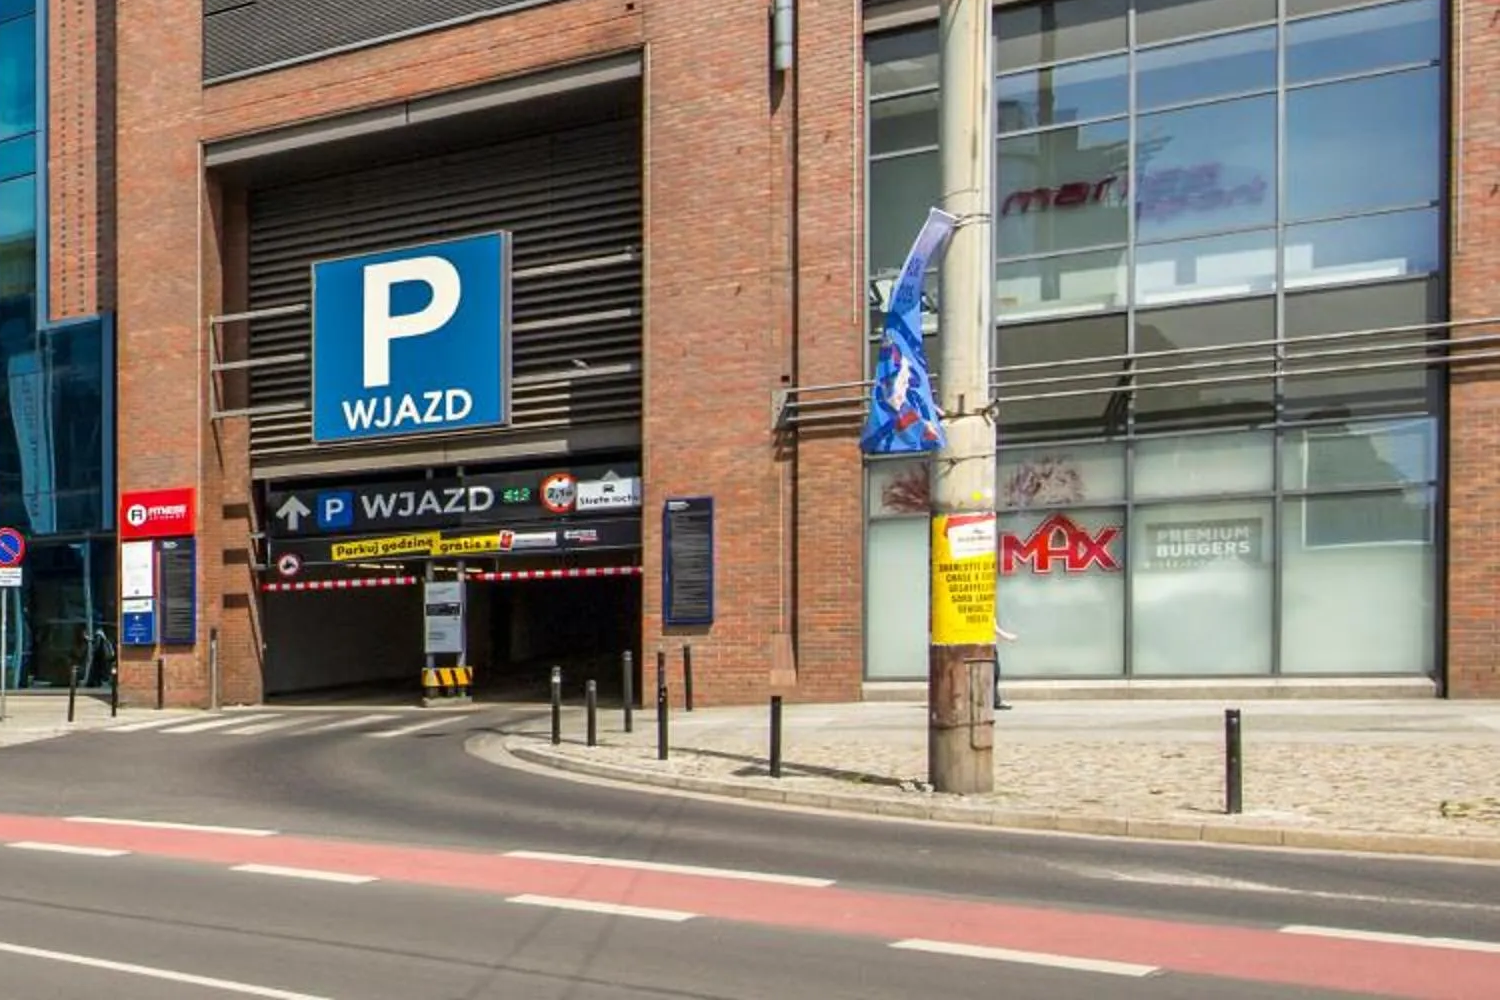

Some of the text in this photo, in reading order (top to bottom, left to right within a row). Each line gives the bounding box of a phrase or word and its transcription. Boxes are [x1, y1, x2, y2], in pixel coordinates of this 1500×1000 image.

[363, 255, 461, 389] P
[342, 388, 473, 431] WJAZD
[325, 486, 495, 522] P WJAZD
[337, 543, 379, 557] Parkuj
[439, 538, 481, 553] gratis
[1001, 512, 1123, 575] MAX
[1156, 525, 1250, 542] PREMIUM
[1156, 540, 1251, 558] BURGERS
